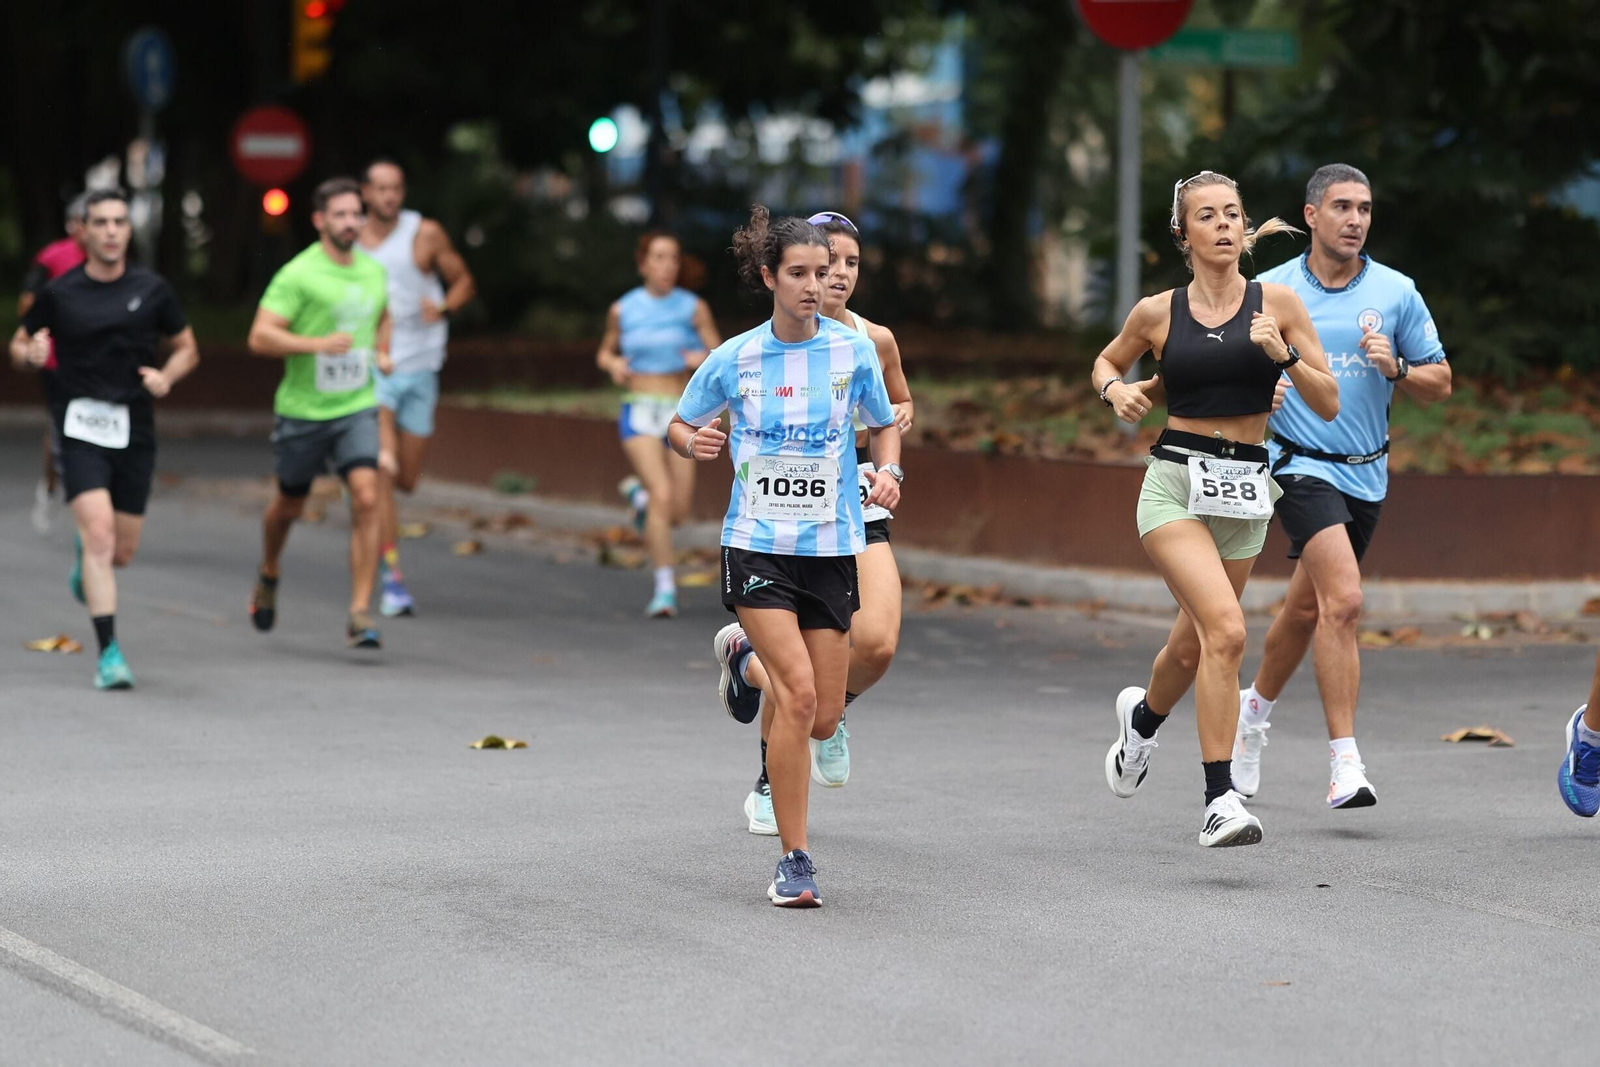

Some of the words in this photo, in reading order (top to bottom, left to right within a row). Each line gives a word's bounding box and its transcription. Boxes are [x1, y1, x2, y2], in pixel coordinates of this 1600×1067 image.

[739, 370, 762, 379] vive
[756, 477, 826, 498] 1036
[1202, 478, 1257, 501] 528
